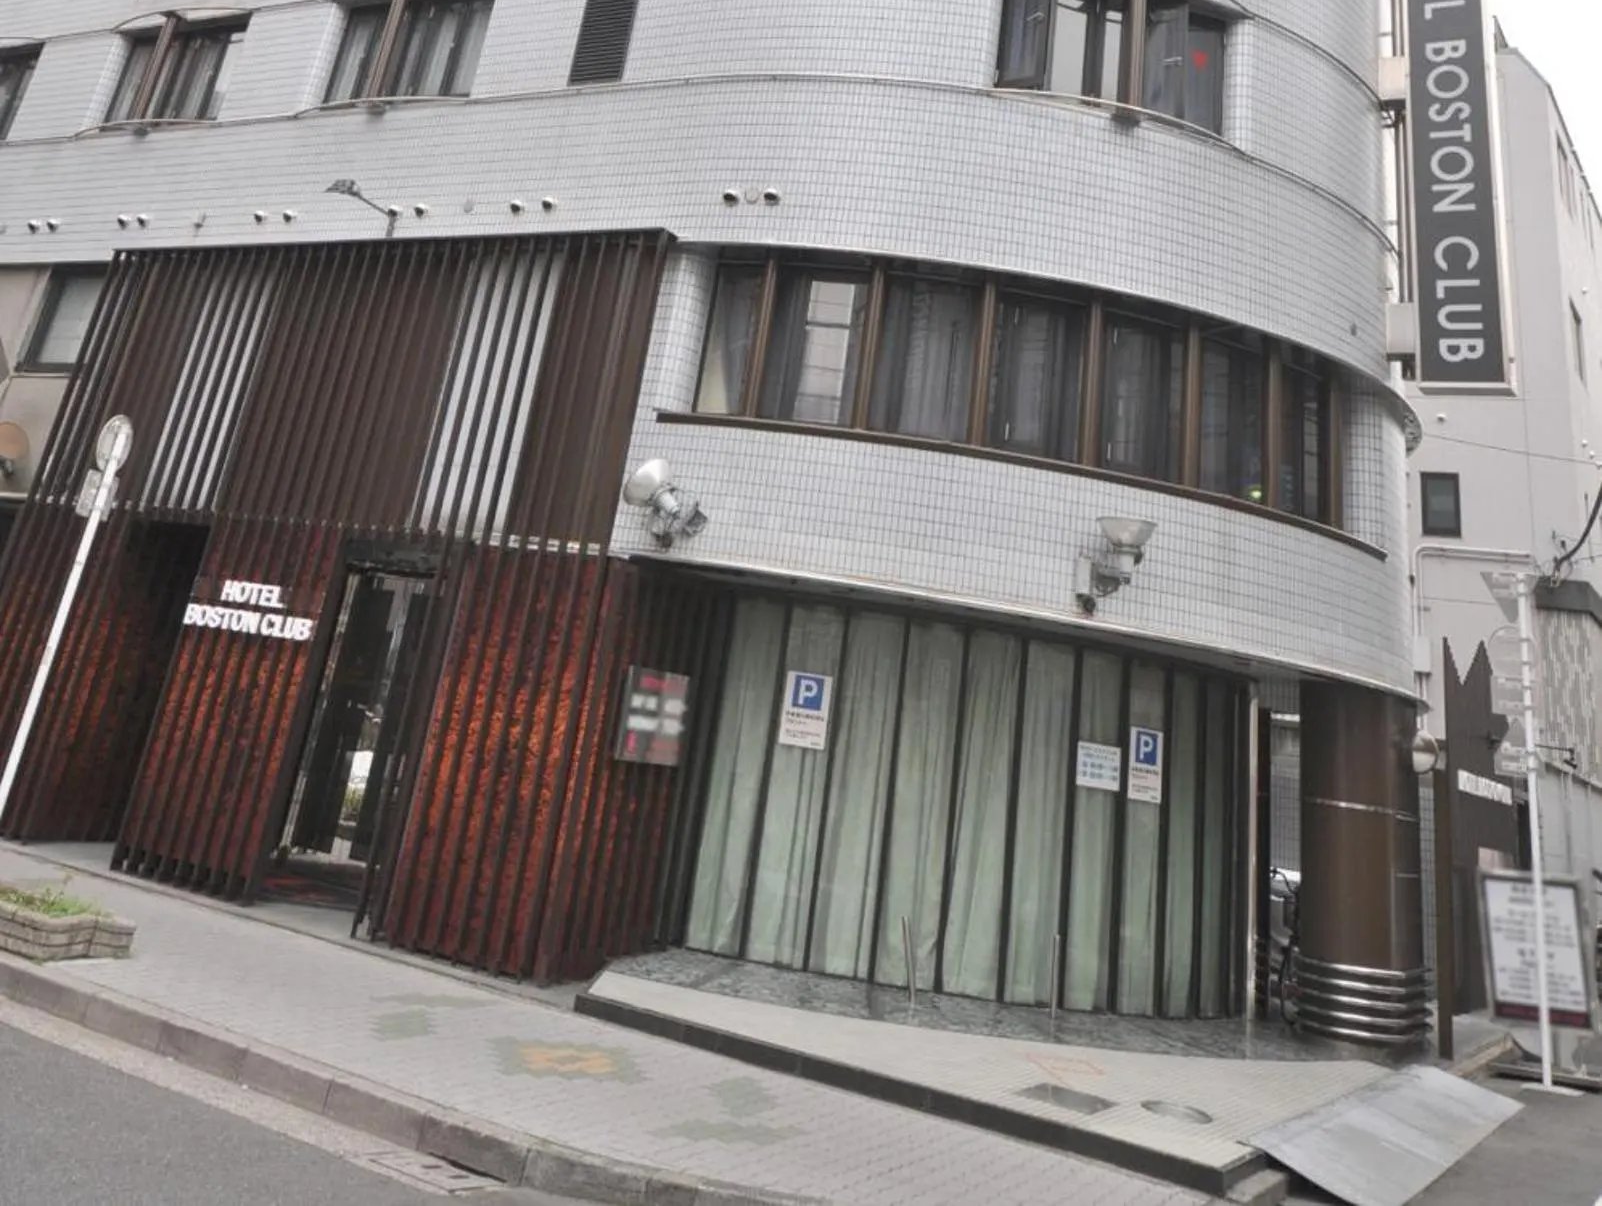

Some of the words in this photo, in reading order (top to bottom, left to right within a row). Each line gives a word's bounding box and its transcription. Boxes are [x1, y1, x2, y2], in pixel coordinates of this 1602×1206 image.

[1425, 39, 1476, 212] BOSTON
[1434, 236, 1485, 363] CLUB
[220, 579, 285, 608] HOTEL
[183, 603, 261, 634] BOSTON
[261, 613, 313, 641] CLUB
[798, 678, 819, 705] P
[1138, 734, 1154, 761] P
